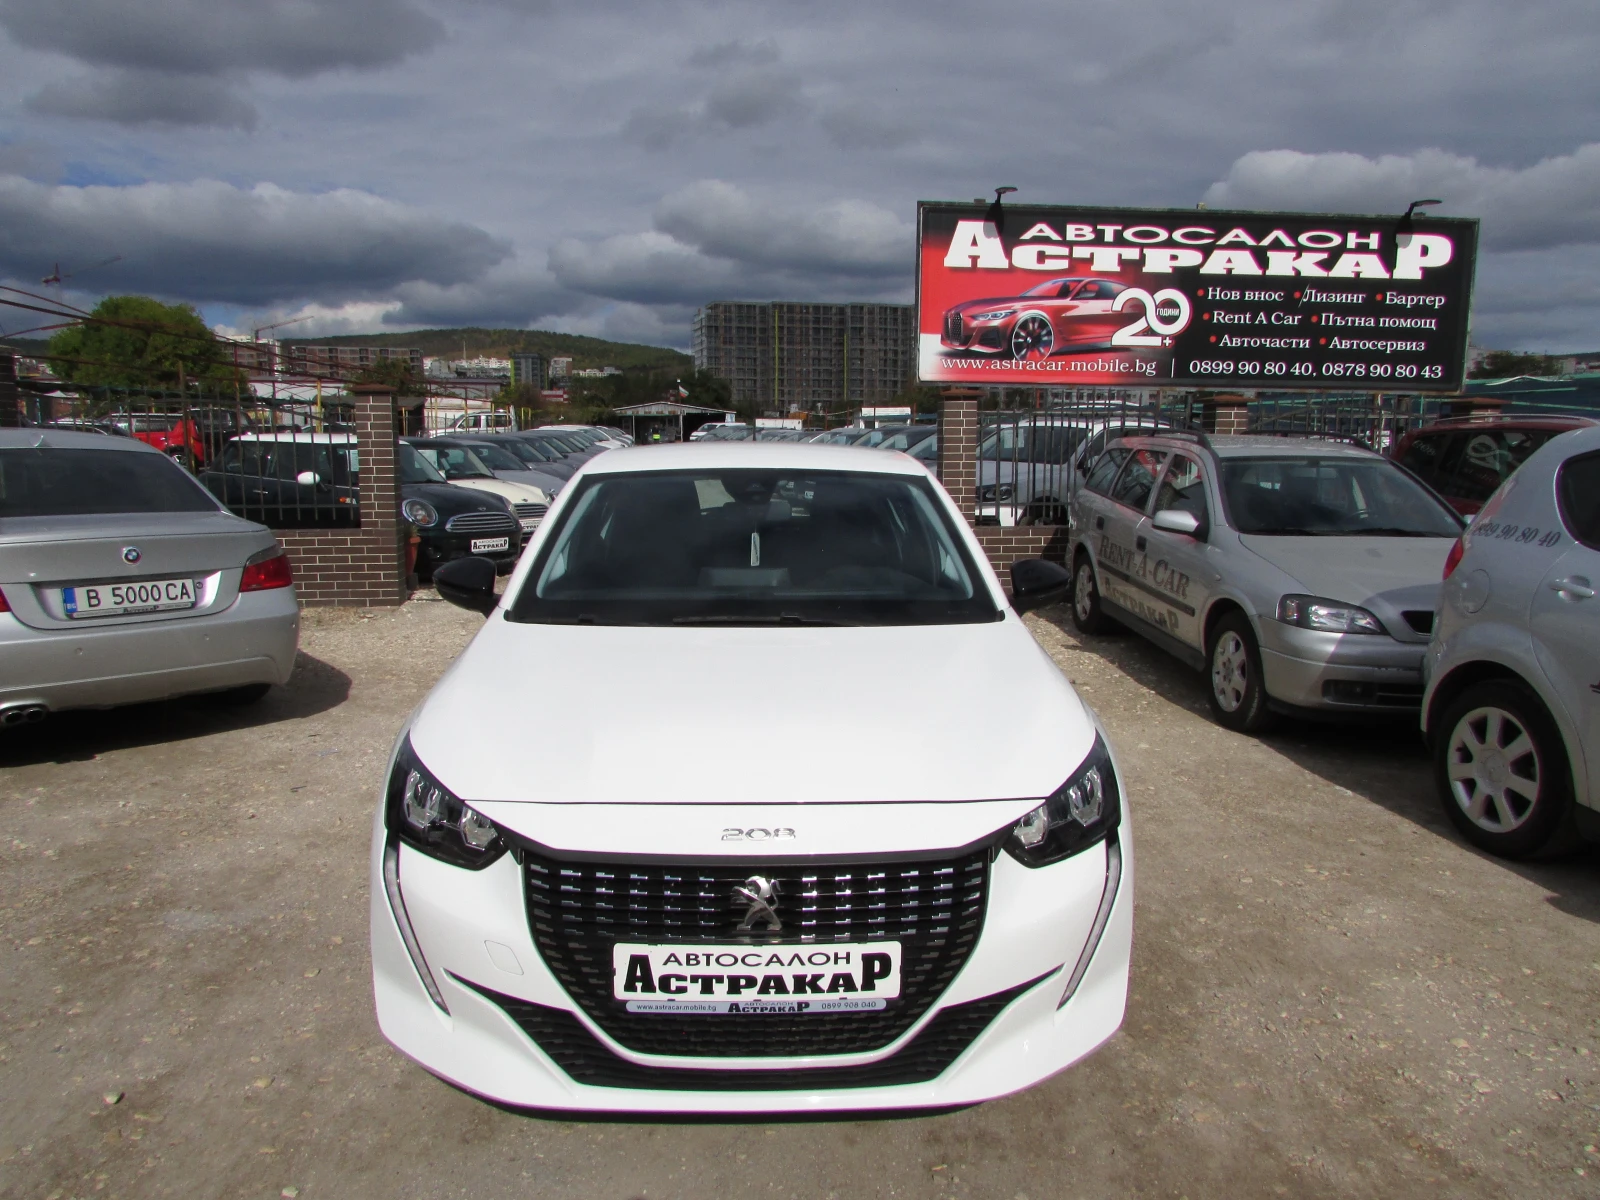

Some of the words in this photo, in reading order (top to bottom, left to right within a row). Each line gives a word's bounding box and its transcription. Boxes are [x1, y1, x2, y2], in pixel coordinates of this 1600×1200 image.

[1019, 223, 1379, 250] АВТОСАЛОН
[1207, 287, 1240, 301] Нов
[1245, 290, 1284, 302] внос
[1302, 288, 1366, 304] Лизинг
[1385, 291, 1445, 309] Бартер
[1156, 307, 1180, 317] ГОДИНИ
[1212, 311, 1252, 325] Rent
[1255, 312, 1268, 325] A
[1271, 312, 1302, 326] Car
[1320, 312, 1375, 328] Пътна
[1379, 316, 1437, 331] помощ
[1219, 334, 1311, 349] Авточасти
[1328, 336, 1425, 353] Автосервиз
[941, 358, 1157, 377] www.astracar.mobile.bg
[1189, 360, 1234, 375] 0899
[1238, 361, 1260, 376] 90
[1264, 361, 1286, 376] 80
[1290, 362, 1317, 378] 40,
[1322, 362, 1366, 377] 0878
[1369, 363, 1392, 378] 90
[1395, 364, 1417, 379] 80
[1420, 365, 1443, 379] 43
[1514, 527, 1539, 544] 80
[1537, 530, 1562, 548] 40
[111, 584, 162, 606] 5000
[720, 827, 797, 841] 208
[662, 951, 851, 967] АВТОСАЛОН
[821, 1002, 842, 1010] 0899
[845, 1001, 859, 1009] 908
[861, 1000, 877, 1009] 040
